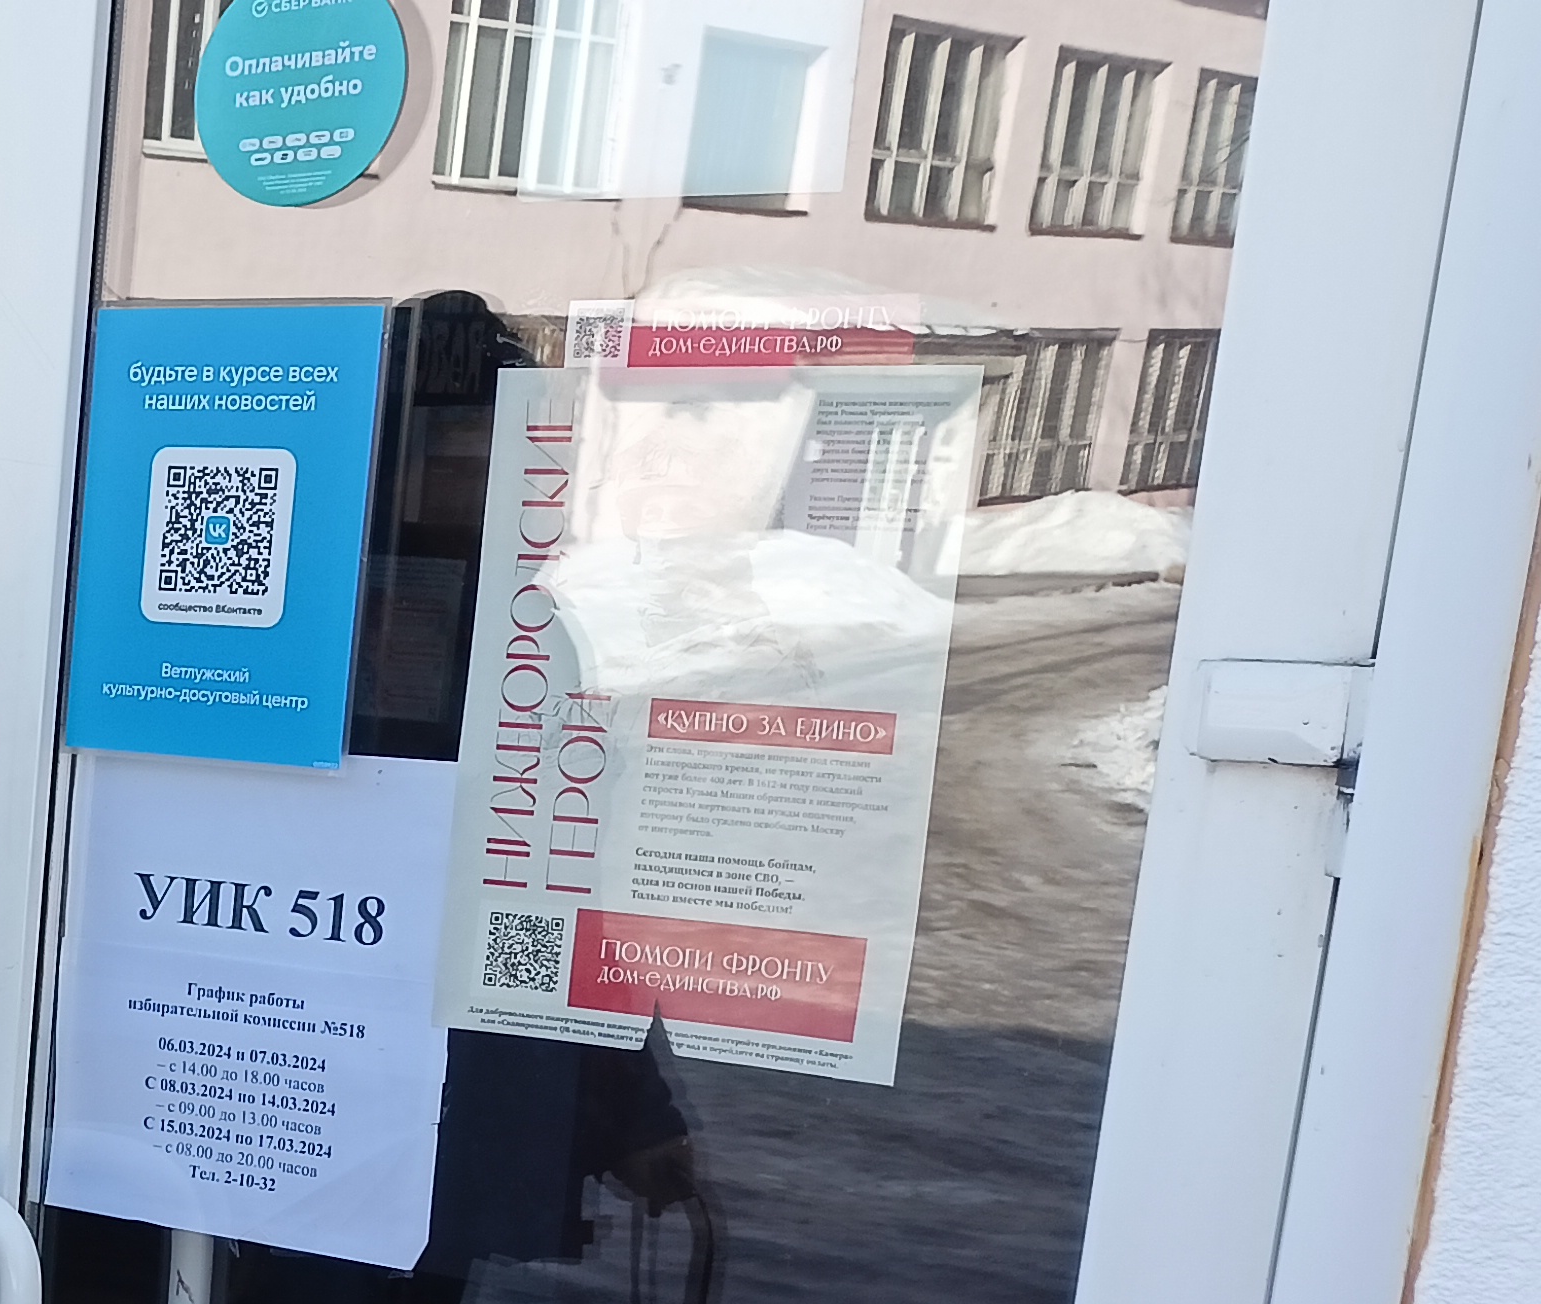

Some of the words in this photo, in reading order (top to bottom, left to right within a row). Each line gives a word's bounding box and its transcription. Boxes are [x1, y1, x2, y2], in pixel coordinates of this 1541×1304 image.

[225, 41, 377, 77] Оплачивайте
[235, 87, 274, 108] как
[280, 75, 363, 108] удобно
[129, 361, 197, 386] будьте
[202, 367, 215, 382] в
[219, 366, 283, 387] курсе
[288, 365, 339, 383] всех
[144, 394, 210, 410] наших
[214, 390, 317, 411] новостей
[158, 602, 213, 613] сообщество
[215, 604, 263, 616] ВКонтакте
[161, 663, 250, 683] Ветлужский
[102, 681, 260, 706] культурно-досуговый
[262, 694, 309, 711] центр
[656, 709, 748, 733] «КУПНО
[756, 715, 786, 736] ЗА
[795, 716, 887, 742] ЕДИНО»
[545, 692, 612, 895] ГЕРОИ
[635, 847, 682, 860] Сегодня
[684, 853, 715, 863] наша
[717, 856, 766, 867] помощь
[767, 858, 817, 874] бойцам,
[134, 872, 272, 934] УИК
[288, 889, 386, 946] 518
[600, 938, 713, 971] ПОМОГИ
[722, 952, 834, 985] ФРОНТУ
[187, 982, 245, 1003] График
[249, 992, 305, 1010] работы
[128, 998, 239, 1022] избирательной
[243, 1013, 316, 1033] комиссии
[320, 1020, 366, 1039] №518
[158, 1037, 232, 1060] 06.03.2024
[236, 1051, 245, 1061] и
[249, 1049, 326, 1073] 07.03.2024
[169, 1062, 177, 1072] с
[182, 1060, 218, 1078] 14.00
[220, 1069, 238, 1081] до
[244, 1069, 280, 1087] 18.00
[284, 1078, 325, 1093] часов
[144, 1076, 157, 1089] С
[160, 1078, 233, 1101] 08.03.2024
[237, 1092, 256, 1104] по
[261, 1093, 336, 1117] 14.03.2024
[167, 1103, 175, 1113] с
[178, 1101, 216, 1118] 09.00
[218, 1111, 236, 1122] до
[242, 1110, 278, 1128] 13.00
[281, 1120, 322, 1135] часов
[143, 1116, 156, 1130] С
[160, 1118, 231, 1142] 15.03.2024
[235, 1133, 253, 1146] по
[258, 1134, 332, 1158] 17.03.2024
[165, 1143, 173, 1153] с
[176, 1142, 213, 1160] 08.00
[215, 1152, 233, 1163] до
[236, 1151, 274, 1170] 20.00
[278, 1161, 317, 1178] часов
[189, 1164, 220, 1182] Тел.
[224, 1170, 276, 1191] 2-10-32
